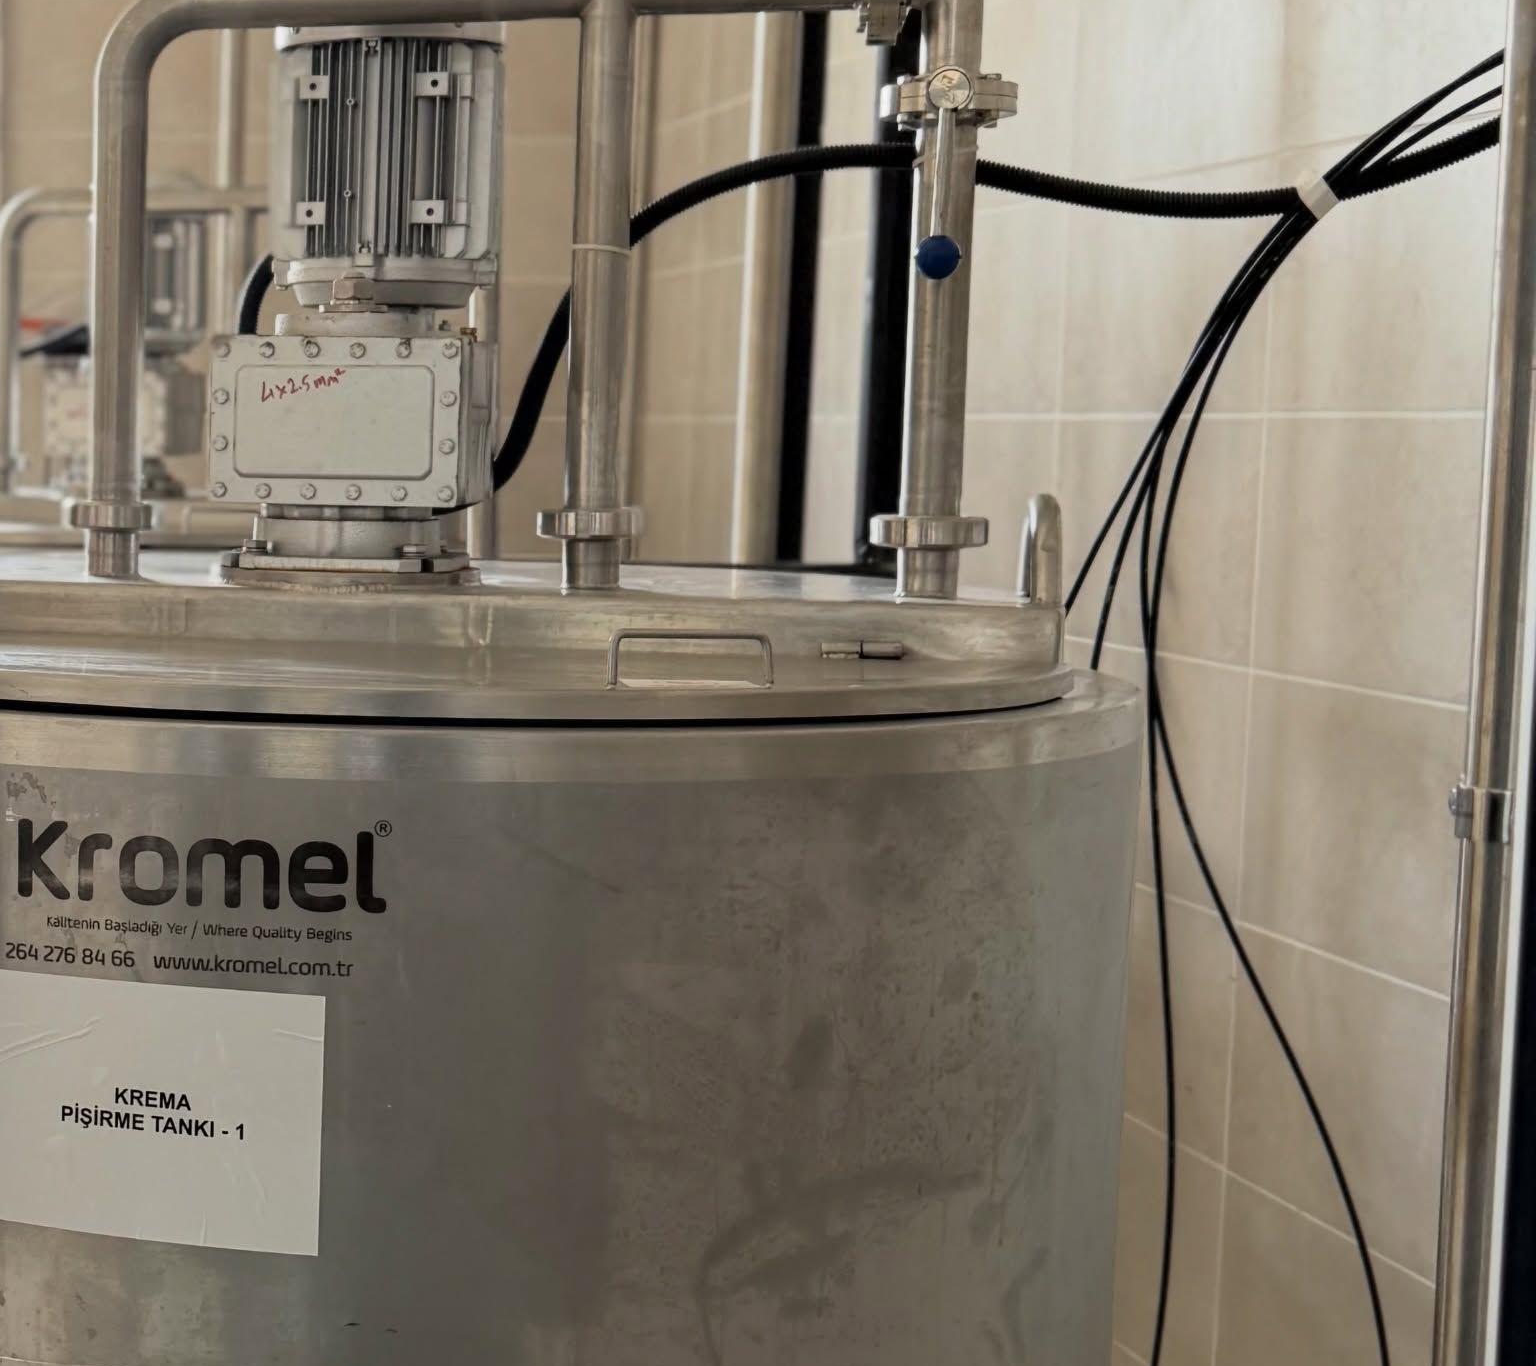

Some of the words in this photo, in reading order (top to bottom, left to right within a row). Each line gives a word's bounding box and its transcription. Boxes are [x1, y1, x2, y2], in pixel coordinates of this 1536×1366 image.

[17, 818, 387, 914] Kromel
[104, 919, 163, 936] Başladığı
[167, 922, 188, 935] Yer
[203, 923, 248, 938] Where
[252, 925, 302, 942] Quality
[306, 927, 353, 944] Begins
[5, 942, 39, 961] 264
[43, 945, 76, 964] 276
[81, 948, 106, 966] 84
[111, 950, 136, 968] 66
[153, 954, 354, 977] www.kromel.com.tr
[114, 1087, 191, 1111] KREMA
[61, 1102, 145, 1131] PİŞİRME
[151, 1115, 215, 1138] TANKI
[235, 1123, 244, 1141] 1
